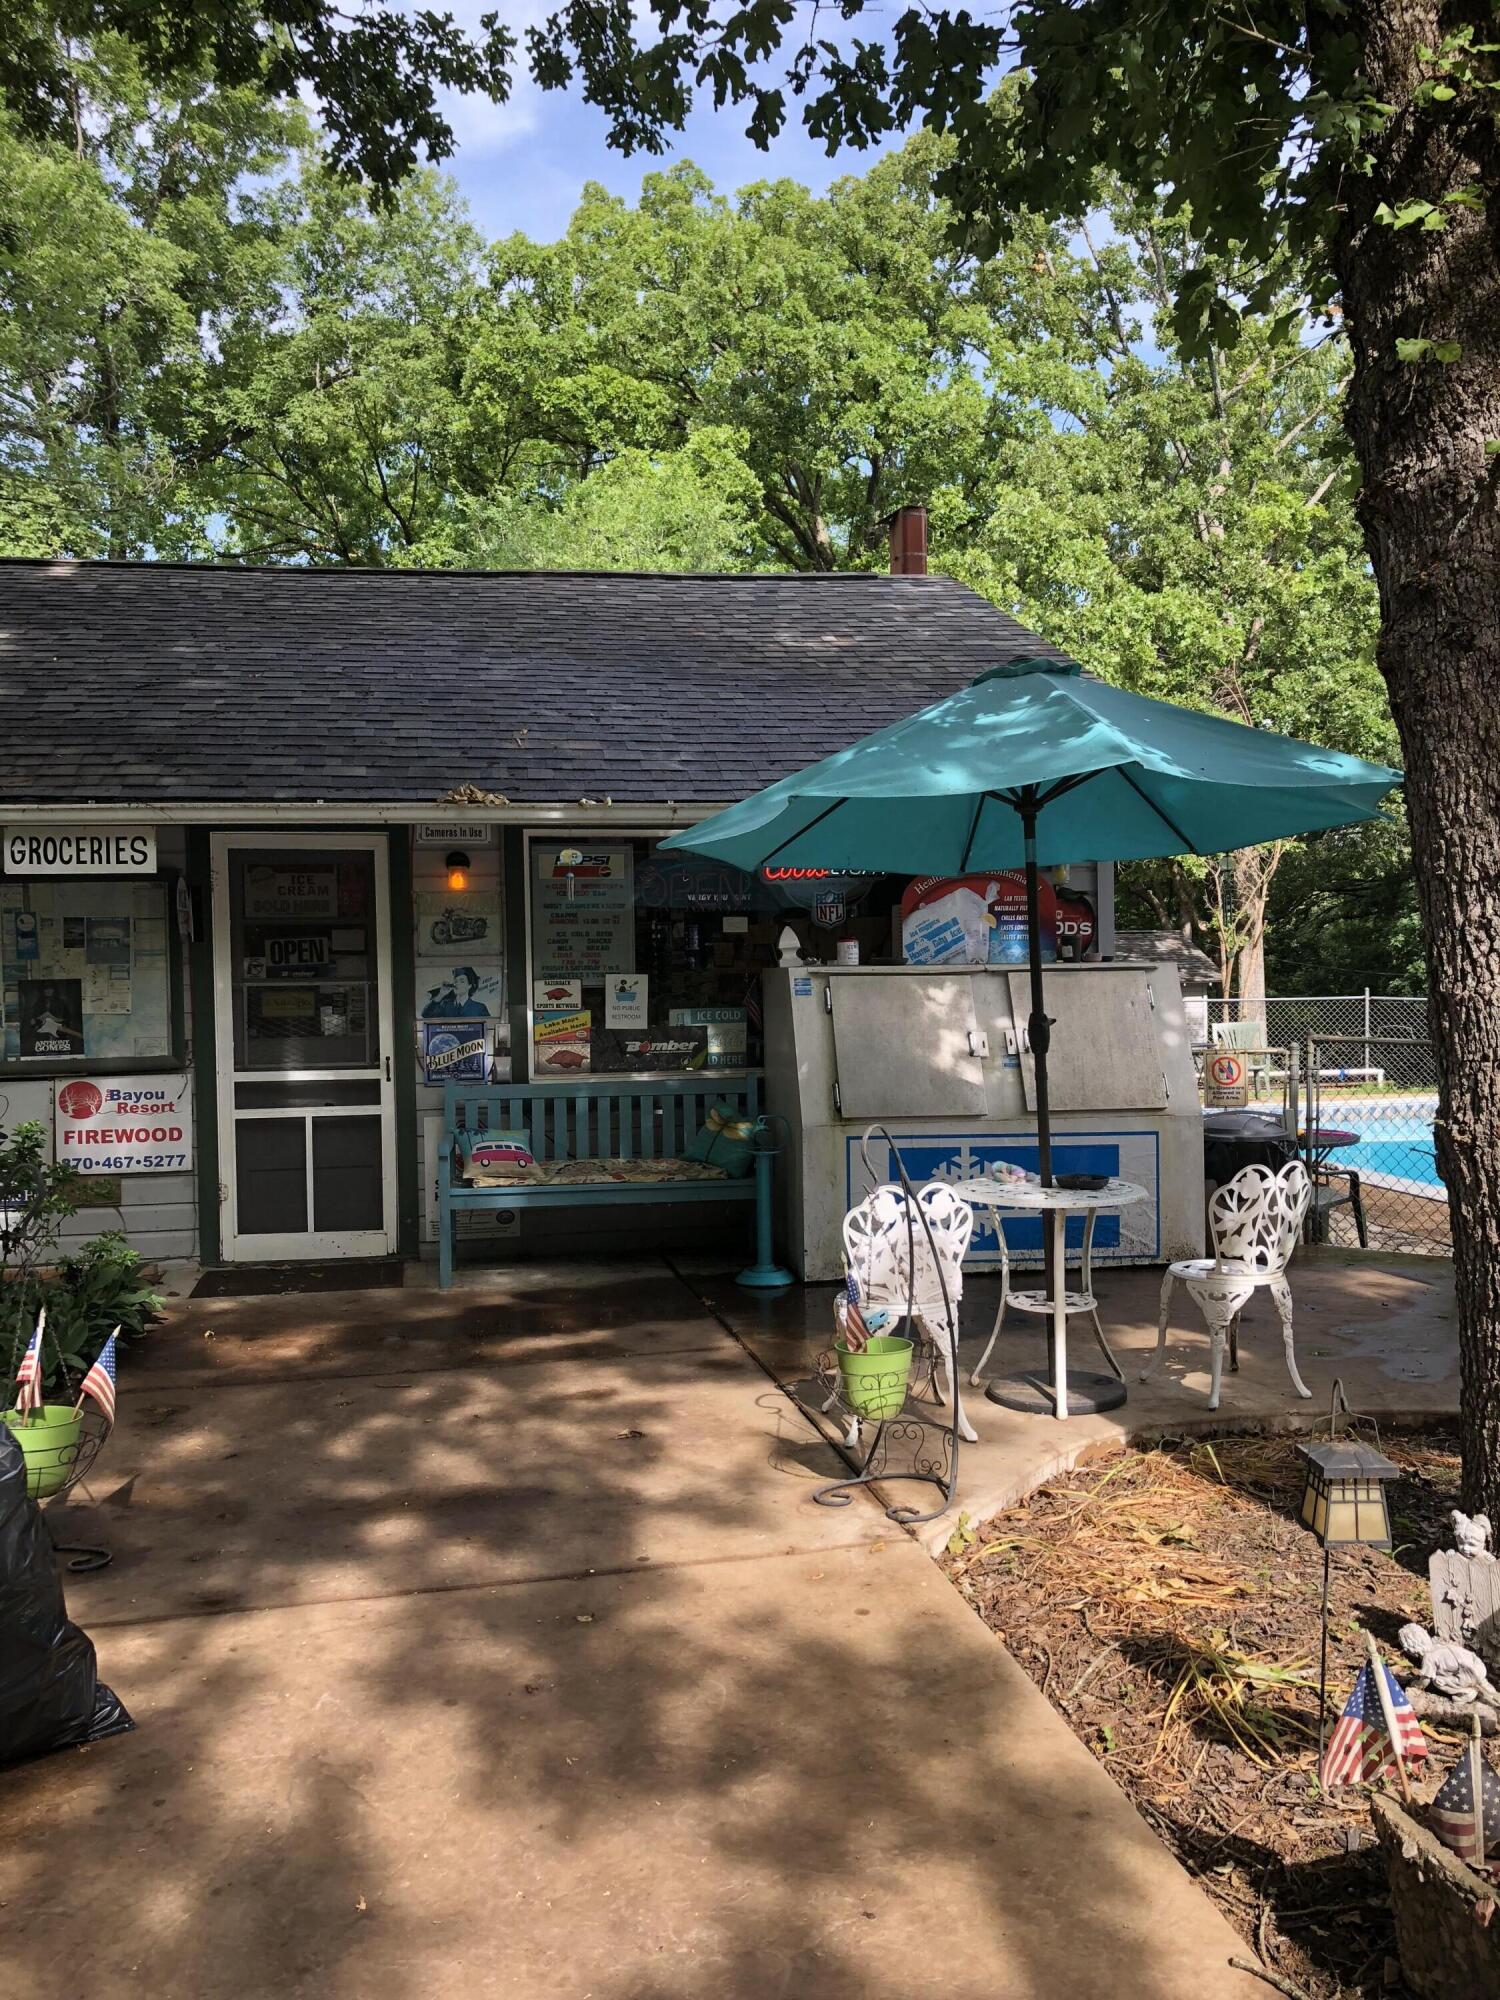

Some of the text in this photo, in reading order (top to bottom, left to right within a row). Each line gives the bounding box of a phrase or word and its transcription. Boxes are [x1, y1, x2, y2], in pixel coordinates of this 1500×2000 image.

[425, 827, 483, 838] Cameras In Use
[11, 836, 148, 866] GROCERIES
[555, 856, 611, 866] PSI
[290, 875, 316, 886] ICE
[278, 886, 329, 897] CREAM
[819, 905, 842, 922] NFL
[271, 939, 324, 965] OPEN
[697, 1010, 741, 1021] ICE COLD
[544, 1017, 579, 1029] Lake Maps
[539, 1027, 569, 1038] Available
[35, 1044, 71, 1052] GOMES
[427, 1041, 484, 1071] BLUE MOON
[720, 1055, 743, 1065] HERE
[110, 1089, 165, 1103] Bayou
[117, 1101, 175, 1114] Resort
[64, 1127, 183, 1144] FIREWOOD
